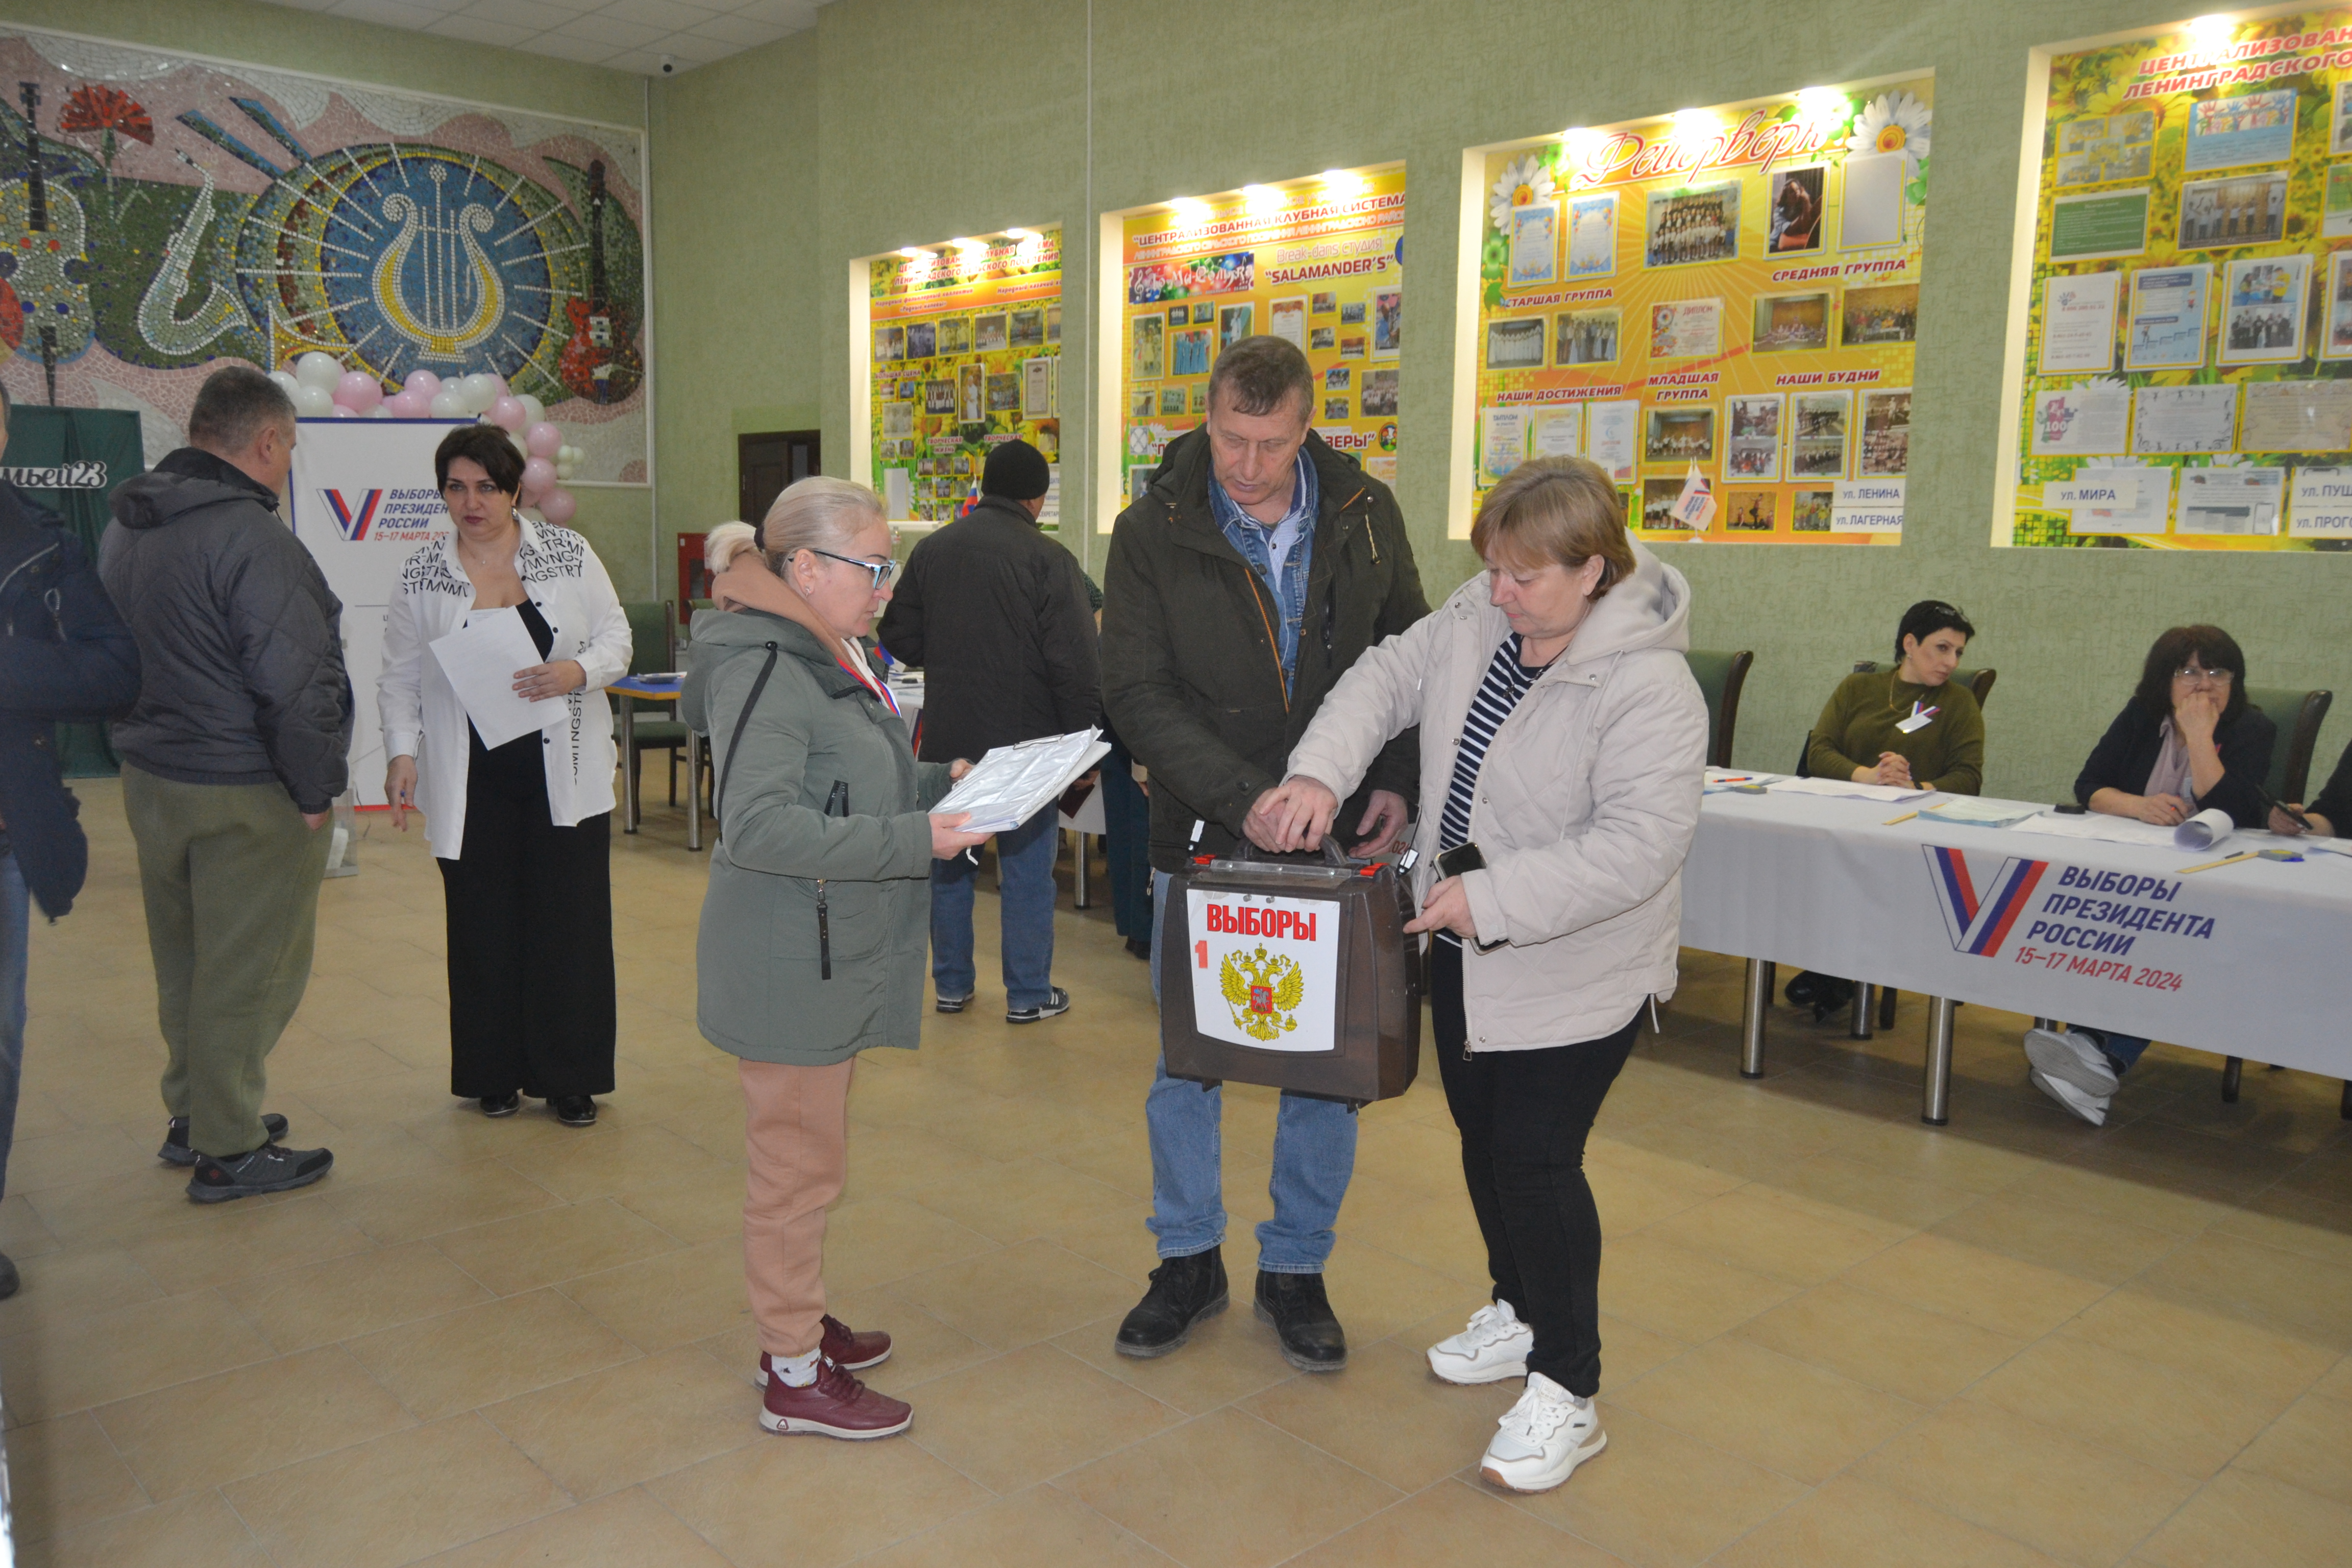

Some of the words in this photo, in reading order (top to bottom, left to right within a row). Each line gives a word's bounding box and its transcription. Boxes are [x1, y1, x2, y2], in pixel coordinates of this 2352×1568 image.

[2123, 50, 2352, 100] ЛЕНИНГРАДСКОГО
[1275, 206, 1338, 224] КЛУБНАЯ
[1772, 265, 1839, 282] СРЕДНЯЯ
[1845, 259, 1906, 275] ГРУППА
[1505, 293, 1560, 308] СТАРШАЯ
[1564, 288, 1613, 303] ГРУППА
[1648, 372, 1719, 386] МЛАДШАЯ
[1776, 373, 1822, 385] НАШИ
[1827, 370, 1880, 383] БУДНИ
[1497, 389, 1533, 402] НАШИ
[1536, 385, 1622, 401] ДОСТИЖЕНИЯ
[1656, 388, 1708, 401] ГРУППА
[1843, 491, 1855, 499] ул.
[1859, 488, 1900, 499] ЛЕНИНА
[2061, 491, 2076, 501] ул.
[2079, 489, 2116, 500] МИРА
[2302, 487, 2319, 497] ул.
[384, 503, 449, 515] ПРЕЗИДЕН
[378, 518, 429, 528] РОССИИ
[1836, 517, 1848, 525] ул.
[1850, 515, 1903, 526] ЛАГЕРНАЯ
[2297, 519, 2312, 528] ул.
[2315, 516, 2352, 528] ПРОГ
[400, 531, 430, 541] МАРТА
[2058, 865, 2183, 902] ВЫБОРЫ
[1206, 903, 1317, 942] ВЫБОРЫ
[2042, 893, 2216, 940] ПРЕЗИДЕНТА
[2026, 920, 2136, 957] РОССИИ
[1194, 940, 1208, 969] 1
[2066, 953, 2132, 983] МАРТА
[2133, 966, 2184, 993] 2024
